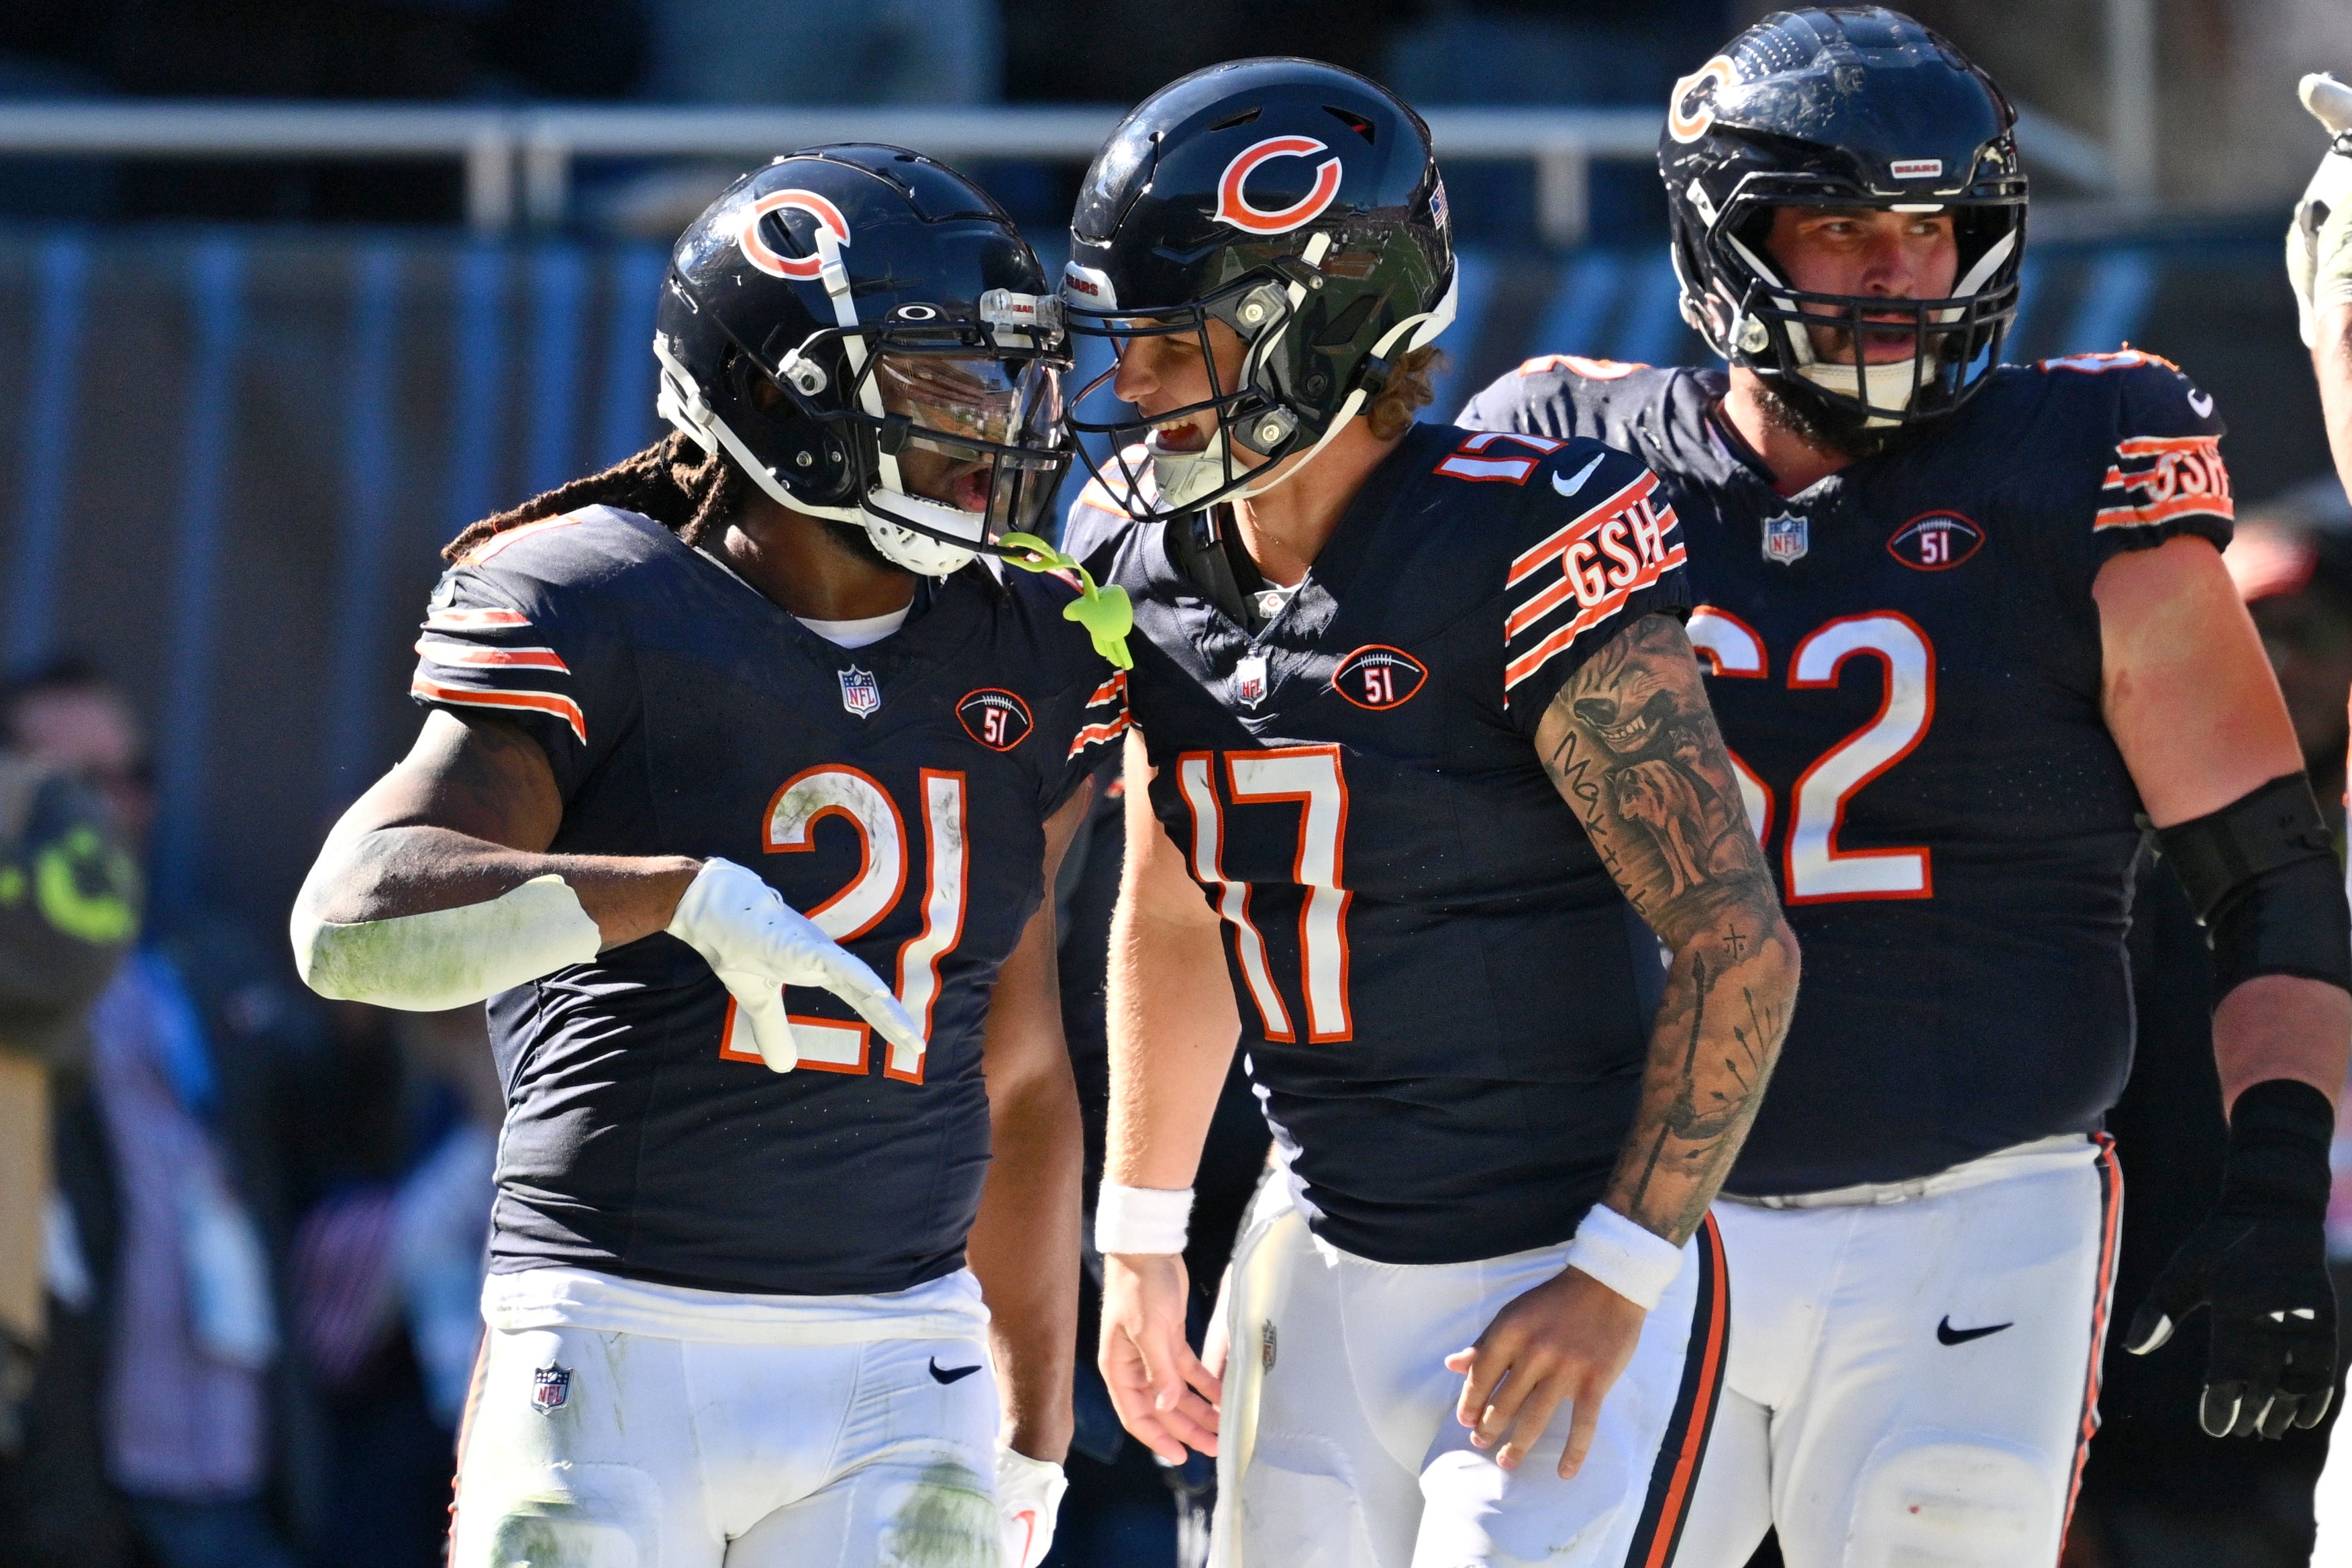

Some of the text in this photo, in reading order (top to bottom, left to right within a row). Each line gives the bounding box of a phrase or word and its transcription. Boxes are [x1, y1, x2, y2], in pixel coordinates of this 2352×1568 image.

[1213, 135, 1342, 235] C
[1894, 164, 1939, 173] BEARS
[1562, 496, 1666, 609] GSH
[1774, 533, 1800, 555] NFL
[1920, 531, 1949, 565] 51
[847, 687, 875, 707] NFL
[1241, 678, 1262, 699] NFL
[1363, 666, 1394, 703] 51
[984, 707, 1008, 745] 51
[1176, 743, 1353, 1043] 17
[719, 763, 969, 1084] 21
[538, 1385, 562, 1405] NFL
